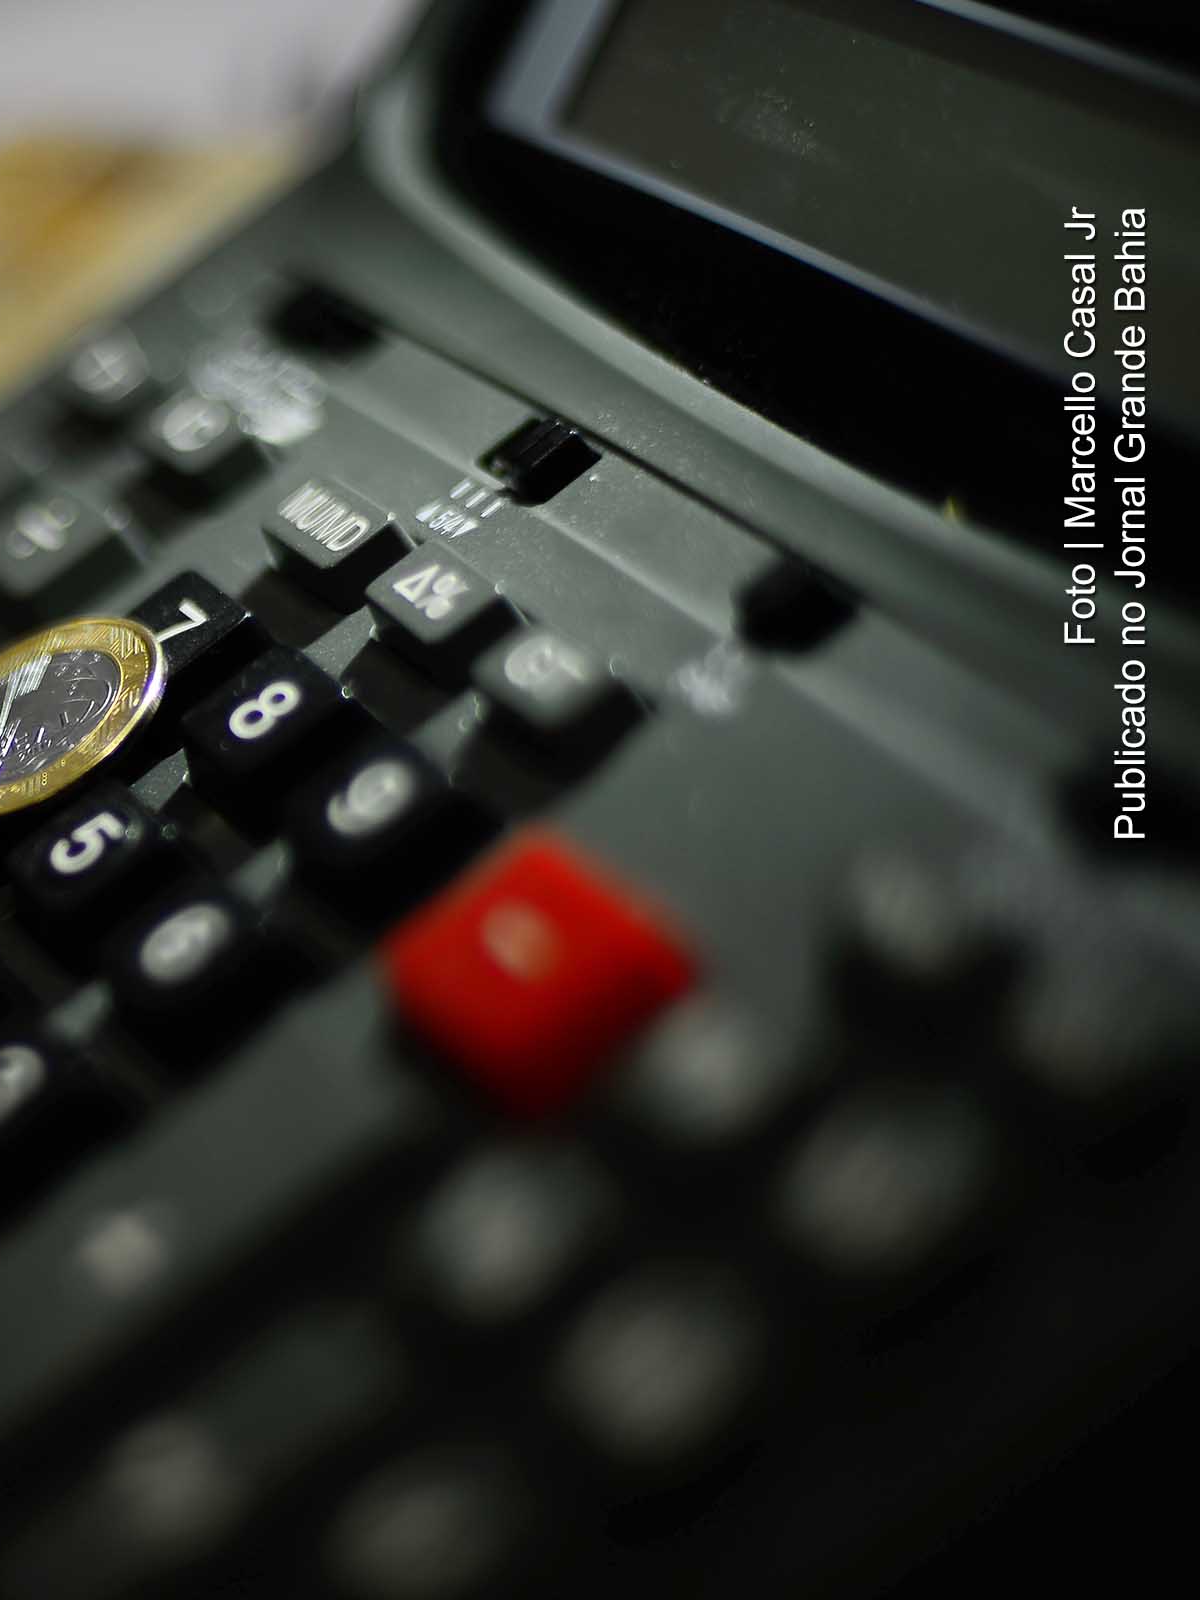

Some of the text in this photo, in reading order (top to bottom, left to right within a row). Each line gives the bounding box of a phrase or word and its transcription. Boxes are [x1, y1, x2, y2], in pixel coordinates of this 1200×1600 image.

[154, 597, 208, 644] 7
[228, 680, 301, 740] 8
[326, 760, 417, 836] 9
[49, 811, 123, 874] 5
